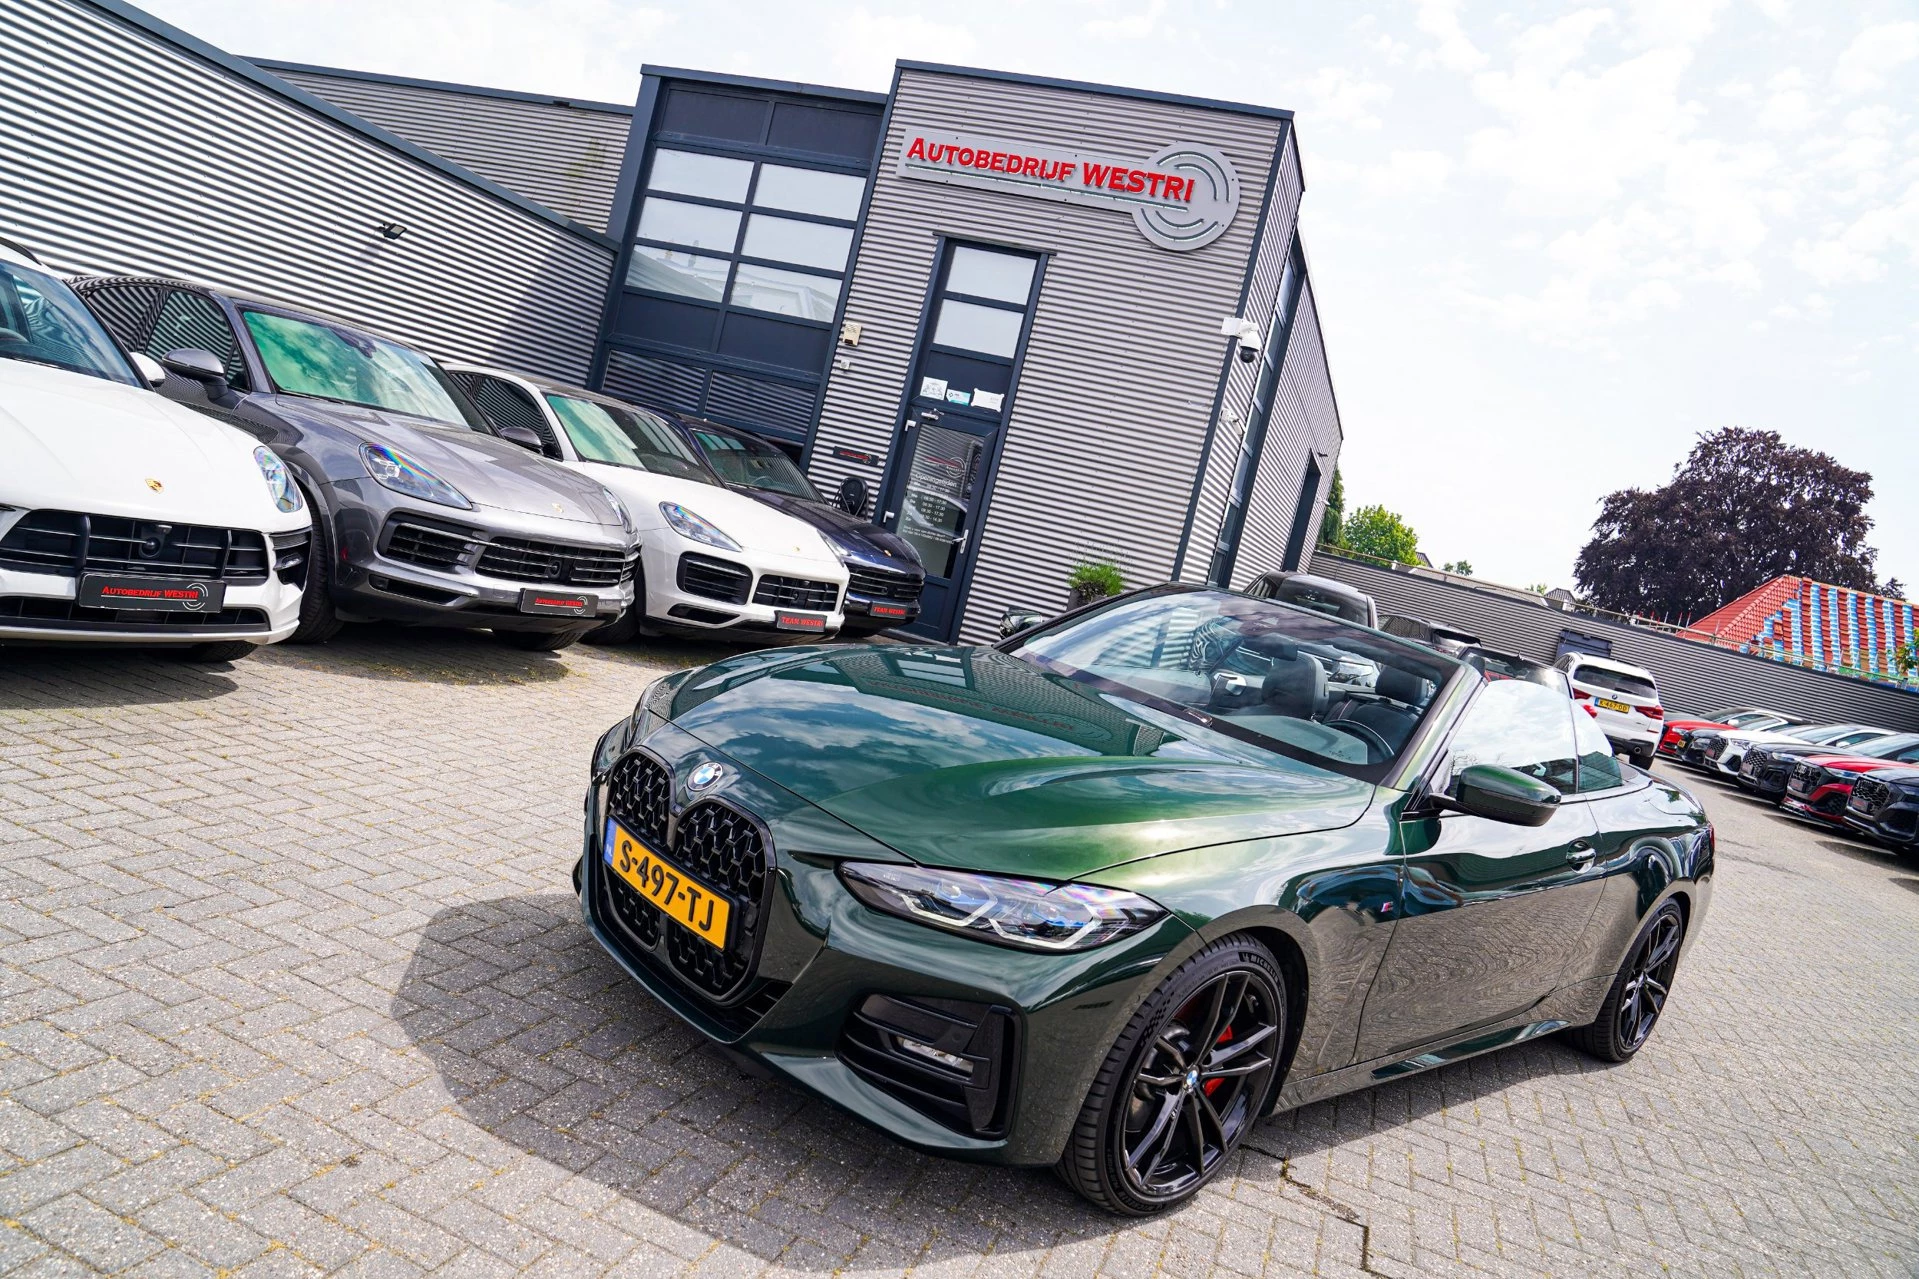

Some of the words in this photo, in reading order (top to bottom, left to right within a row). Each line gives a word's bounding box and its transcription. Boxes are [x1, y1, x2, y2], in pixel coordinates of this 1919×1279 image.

[906, 137, 1076, 182] AUTOBEDRIJF
[1082, 161, 1196, 203] WESTRI
[102, 585, 162, 598] AUTOBEDRIJF
[164, 589, 199, 600] WESTRI
[619, 839, 715, 932] S-497-TJ
